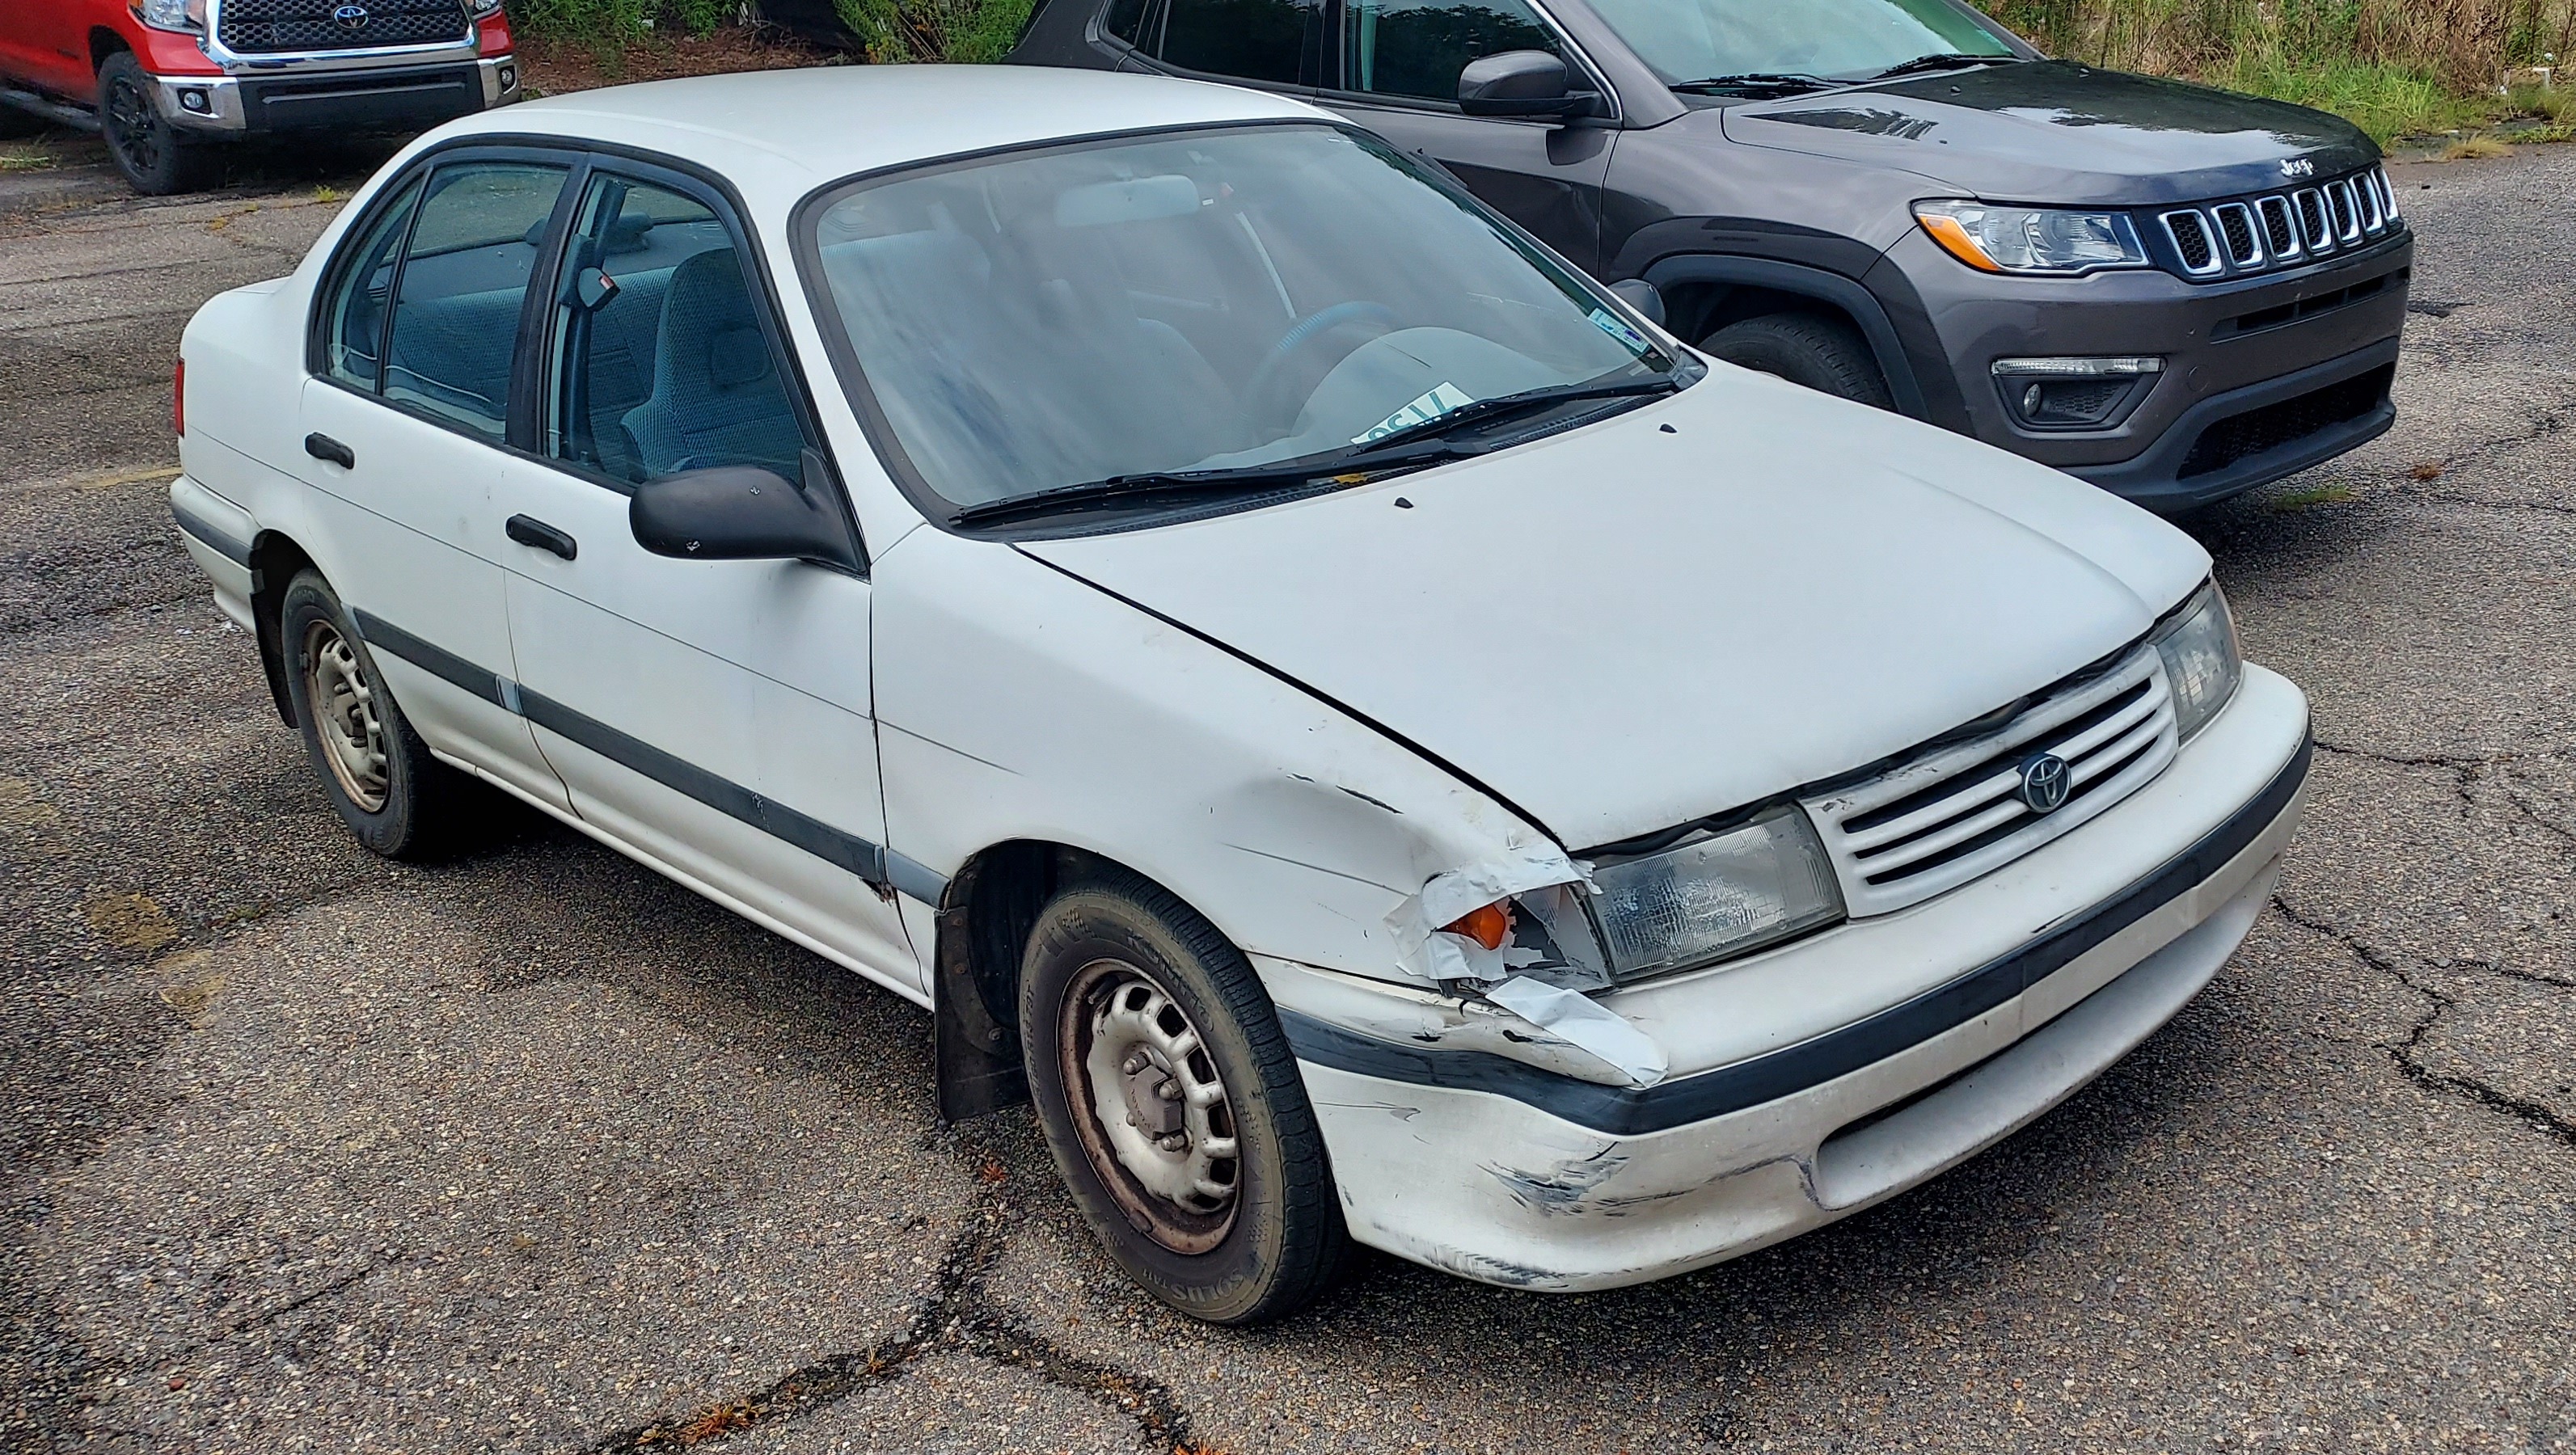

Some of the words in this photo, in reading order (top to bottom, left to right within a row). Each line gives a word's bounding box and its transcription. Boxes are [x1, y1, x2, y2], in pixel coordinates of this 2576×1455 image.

[2280, 158, 2313, 176] Jeep
[1126, 926, 1214, 1032] KUMHO
[1171, 1267, 1244, 1303] SOLUS
